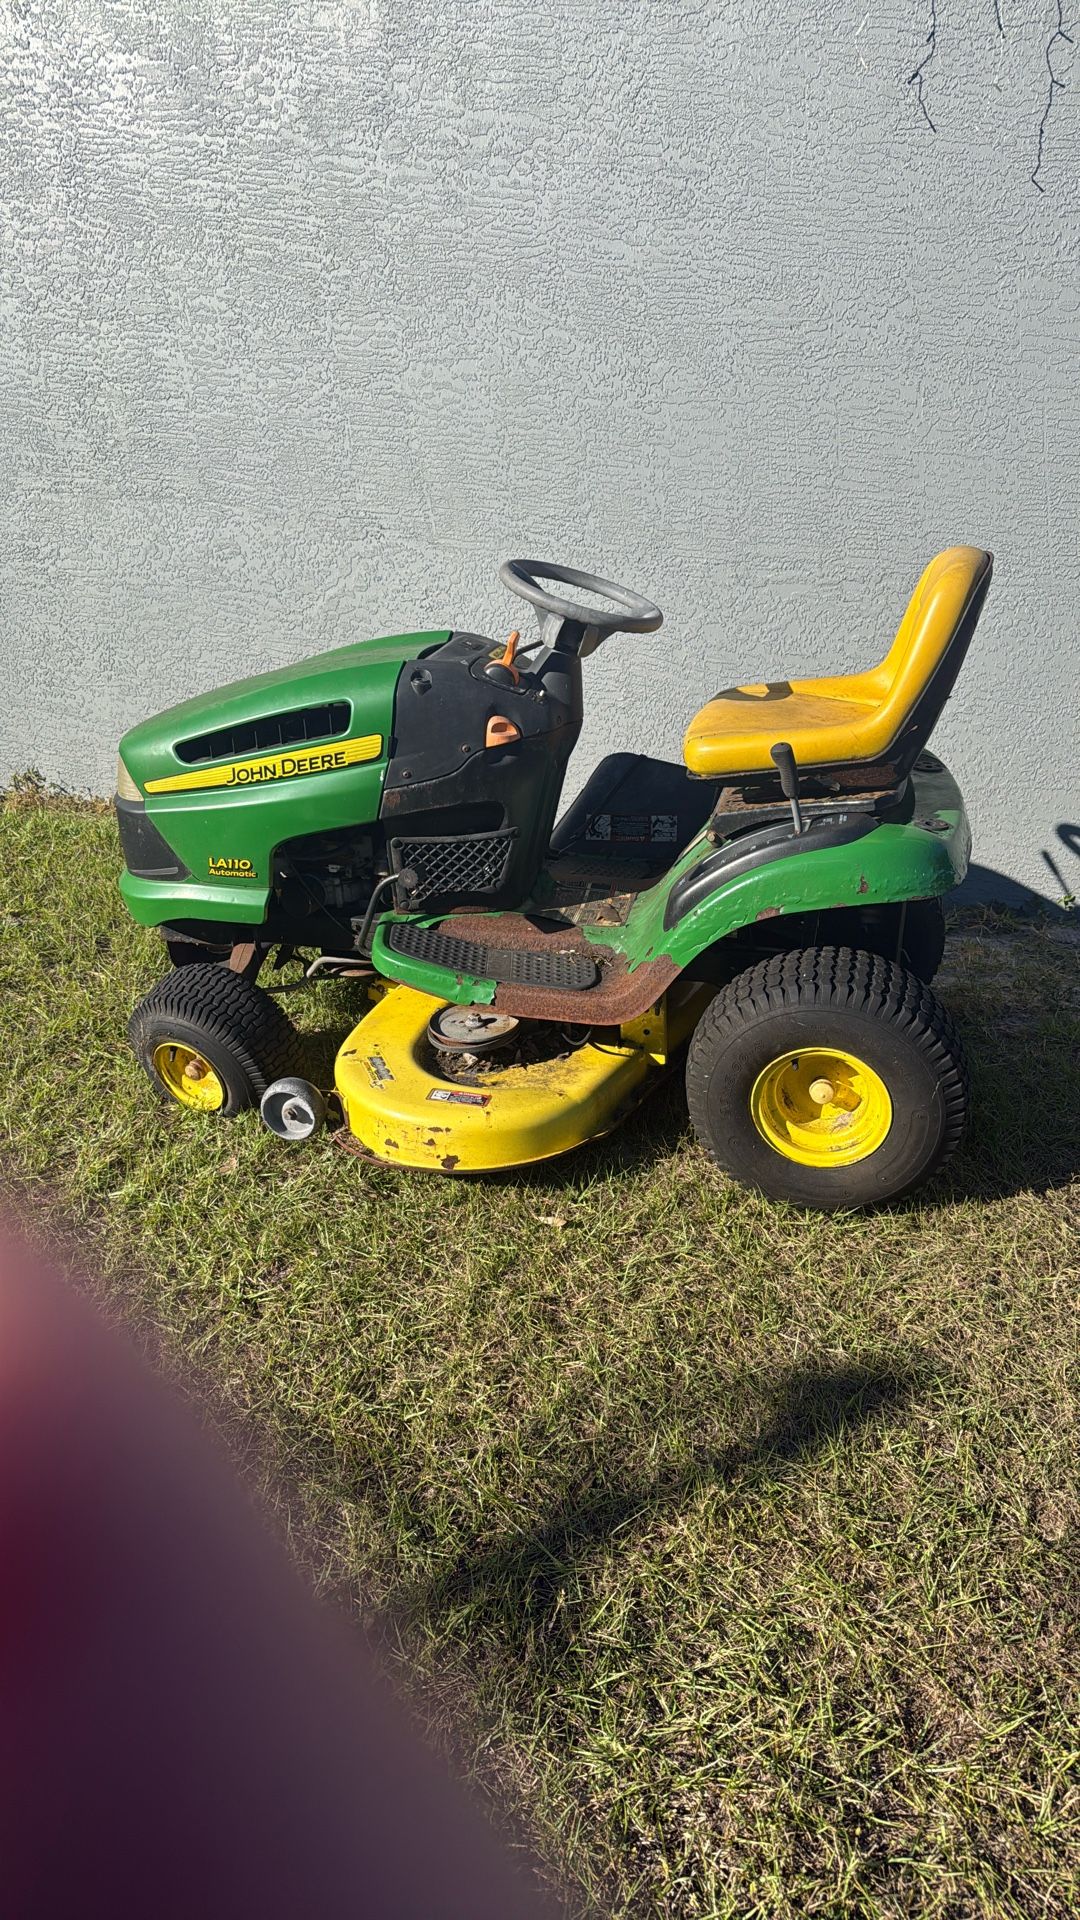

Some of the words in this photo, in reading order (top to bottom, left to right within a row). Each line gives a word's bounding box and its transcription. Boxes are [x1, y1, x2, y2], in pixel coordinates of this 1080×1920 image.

[226, 763, 278, 784] JOHN
[281, 751, 347, 775] DEERE
[208, 857, 252, 869] LA110
[208, 868, 257, 878] Automatic
